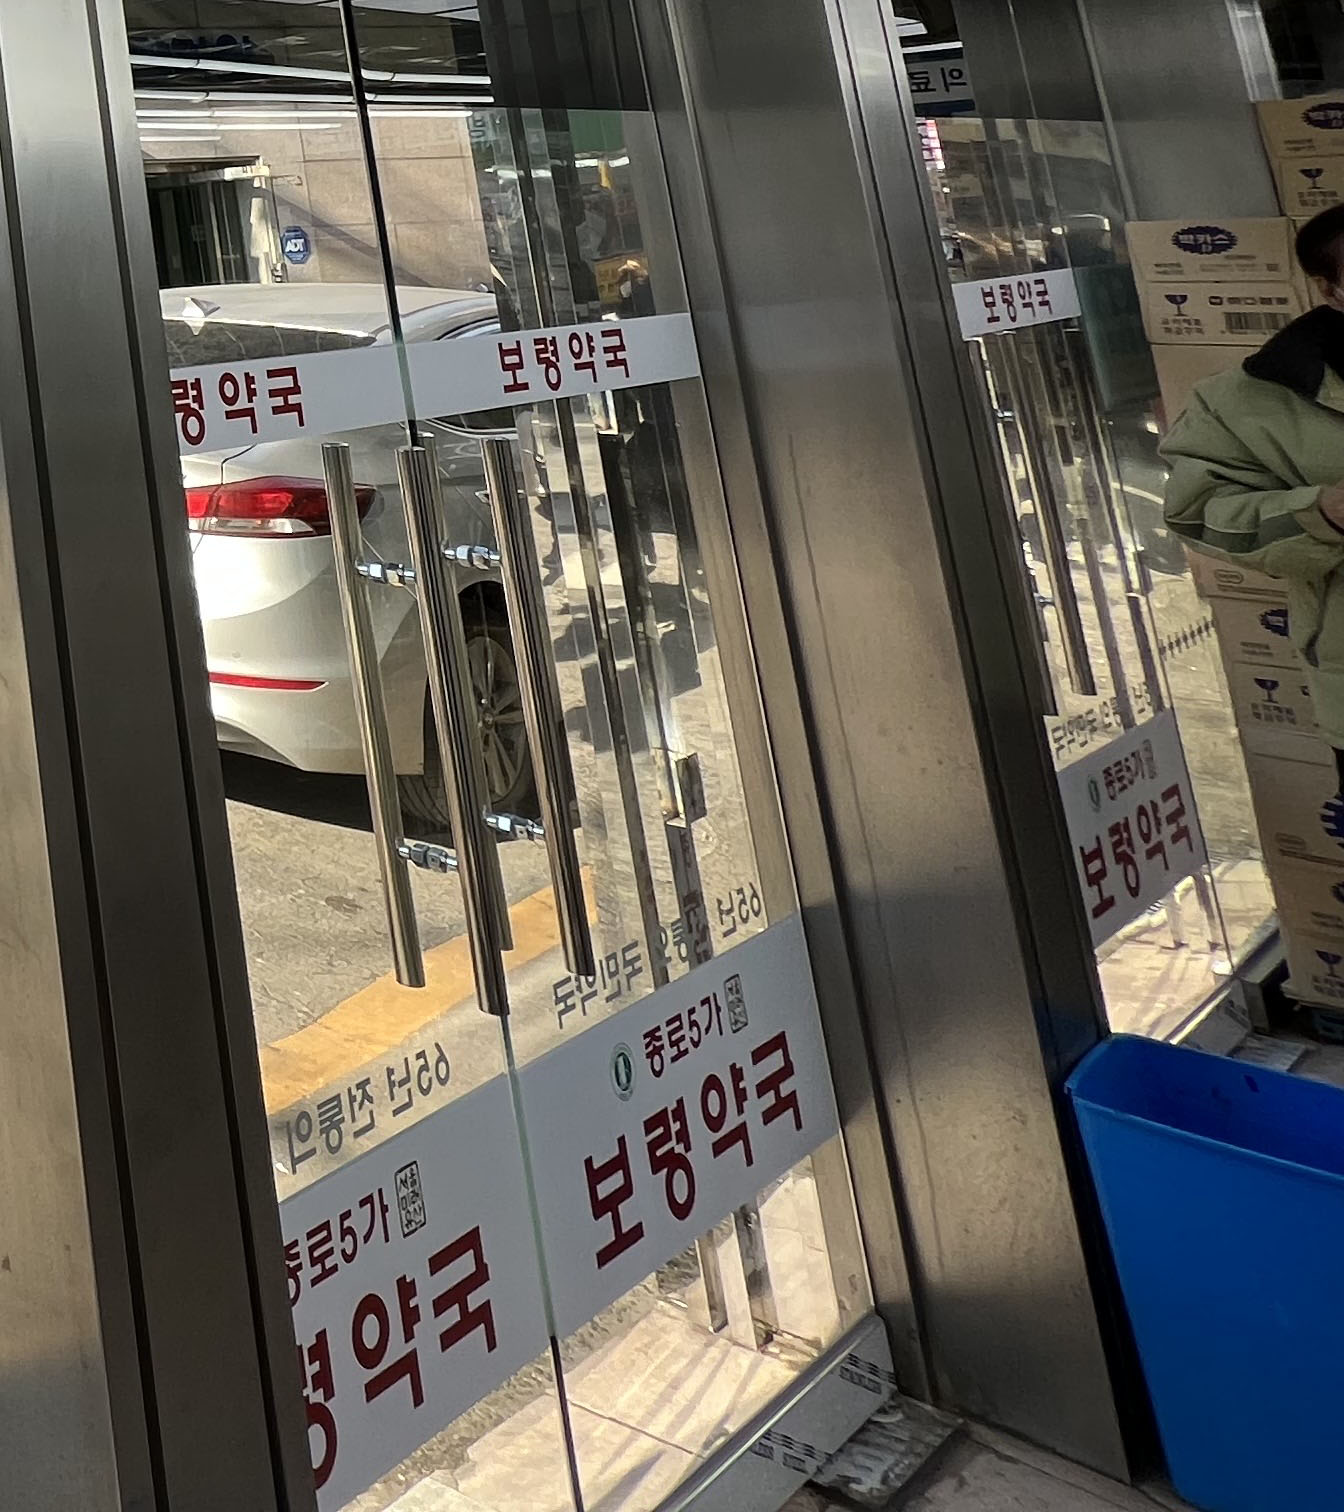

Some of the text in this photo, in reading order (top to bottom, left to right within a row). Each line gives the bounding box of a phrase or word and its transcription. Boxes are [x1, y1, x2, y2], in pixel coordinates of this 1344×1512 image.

[284, 239, 305, 254] ADT
[981, 278, 1053, 323] 보령약국
[498, 328, 630, 394] 보령약국
[171, 367, 304, 445] 령약국
[1080, 783, 1193, 919] 보령약국
[643, 992, 724, 1078] 종로5가
[584, 1031, 804, 1270] 보령약국
